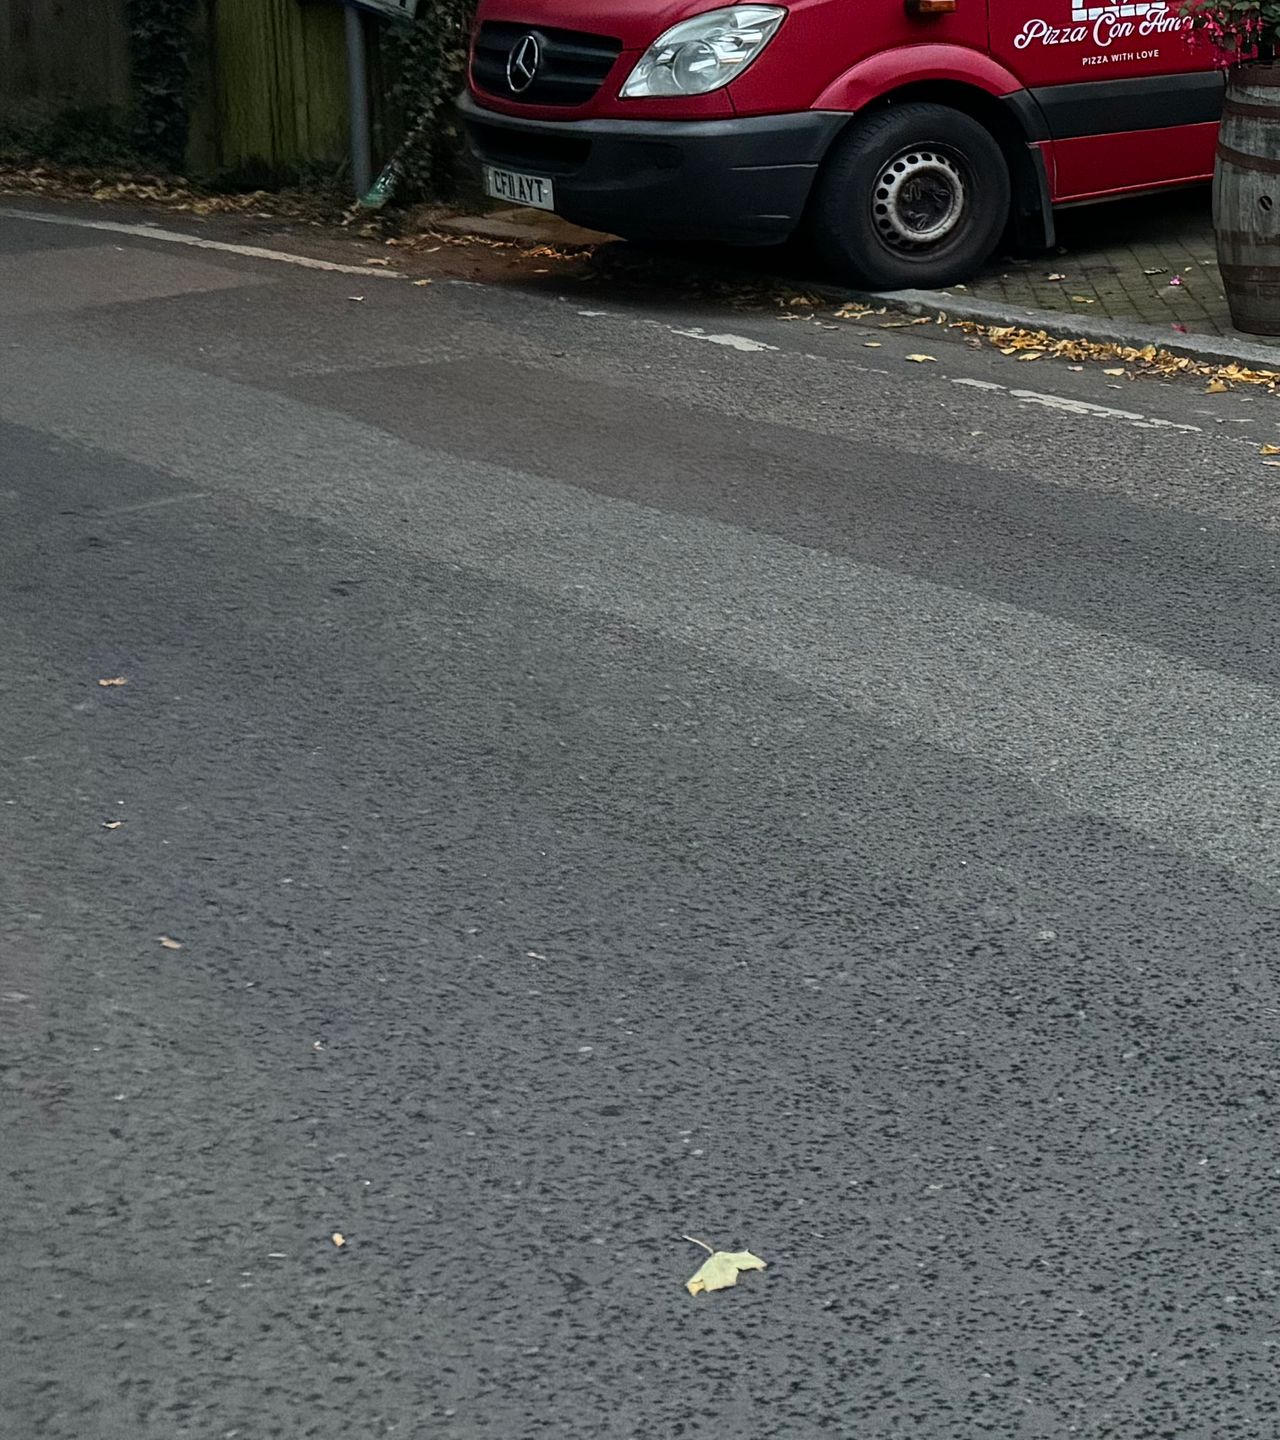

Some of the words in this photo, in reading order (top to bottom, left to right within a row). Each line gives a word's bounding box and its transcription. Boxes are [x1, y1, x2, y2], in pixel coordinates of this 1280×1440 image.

[1013, 18, 1088, 50] Pizza
[1093, 13, 1135, 47] Con
[1082, 55, 1109, 66] PIZZA
[1111, 53, 1134, 63] WITH
[1136, 50, 1160, 60] LOVE
[519, 176, 543, 203] AYT
